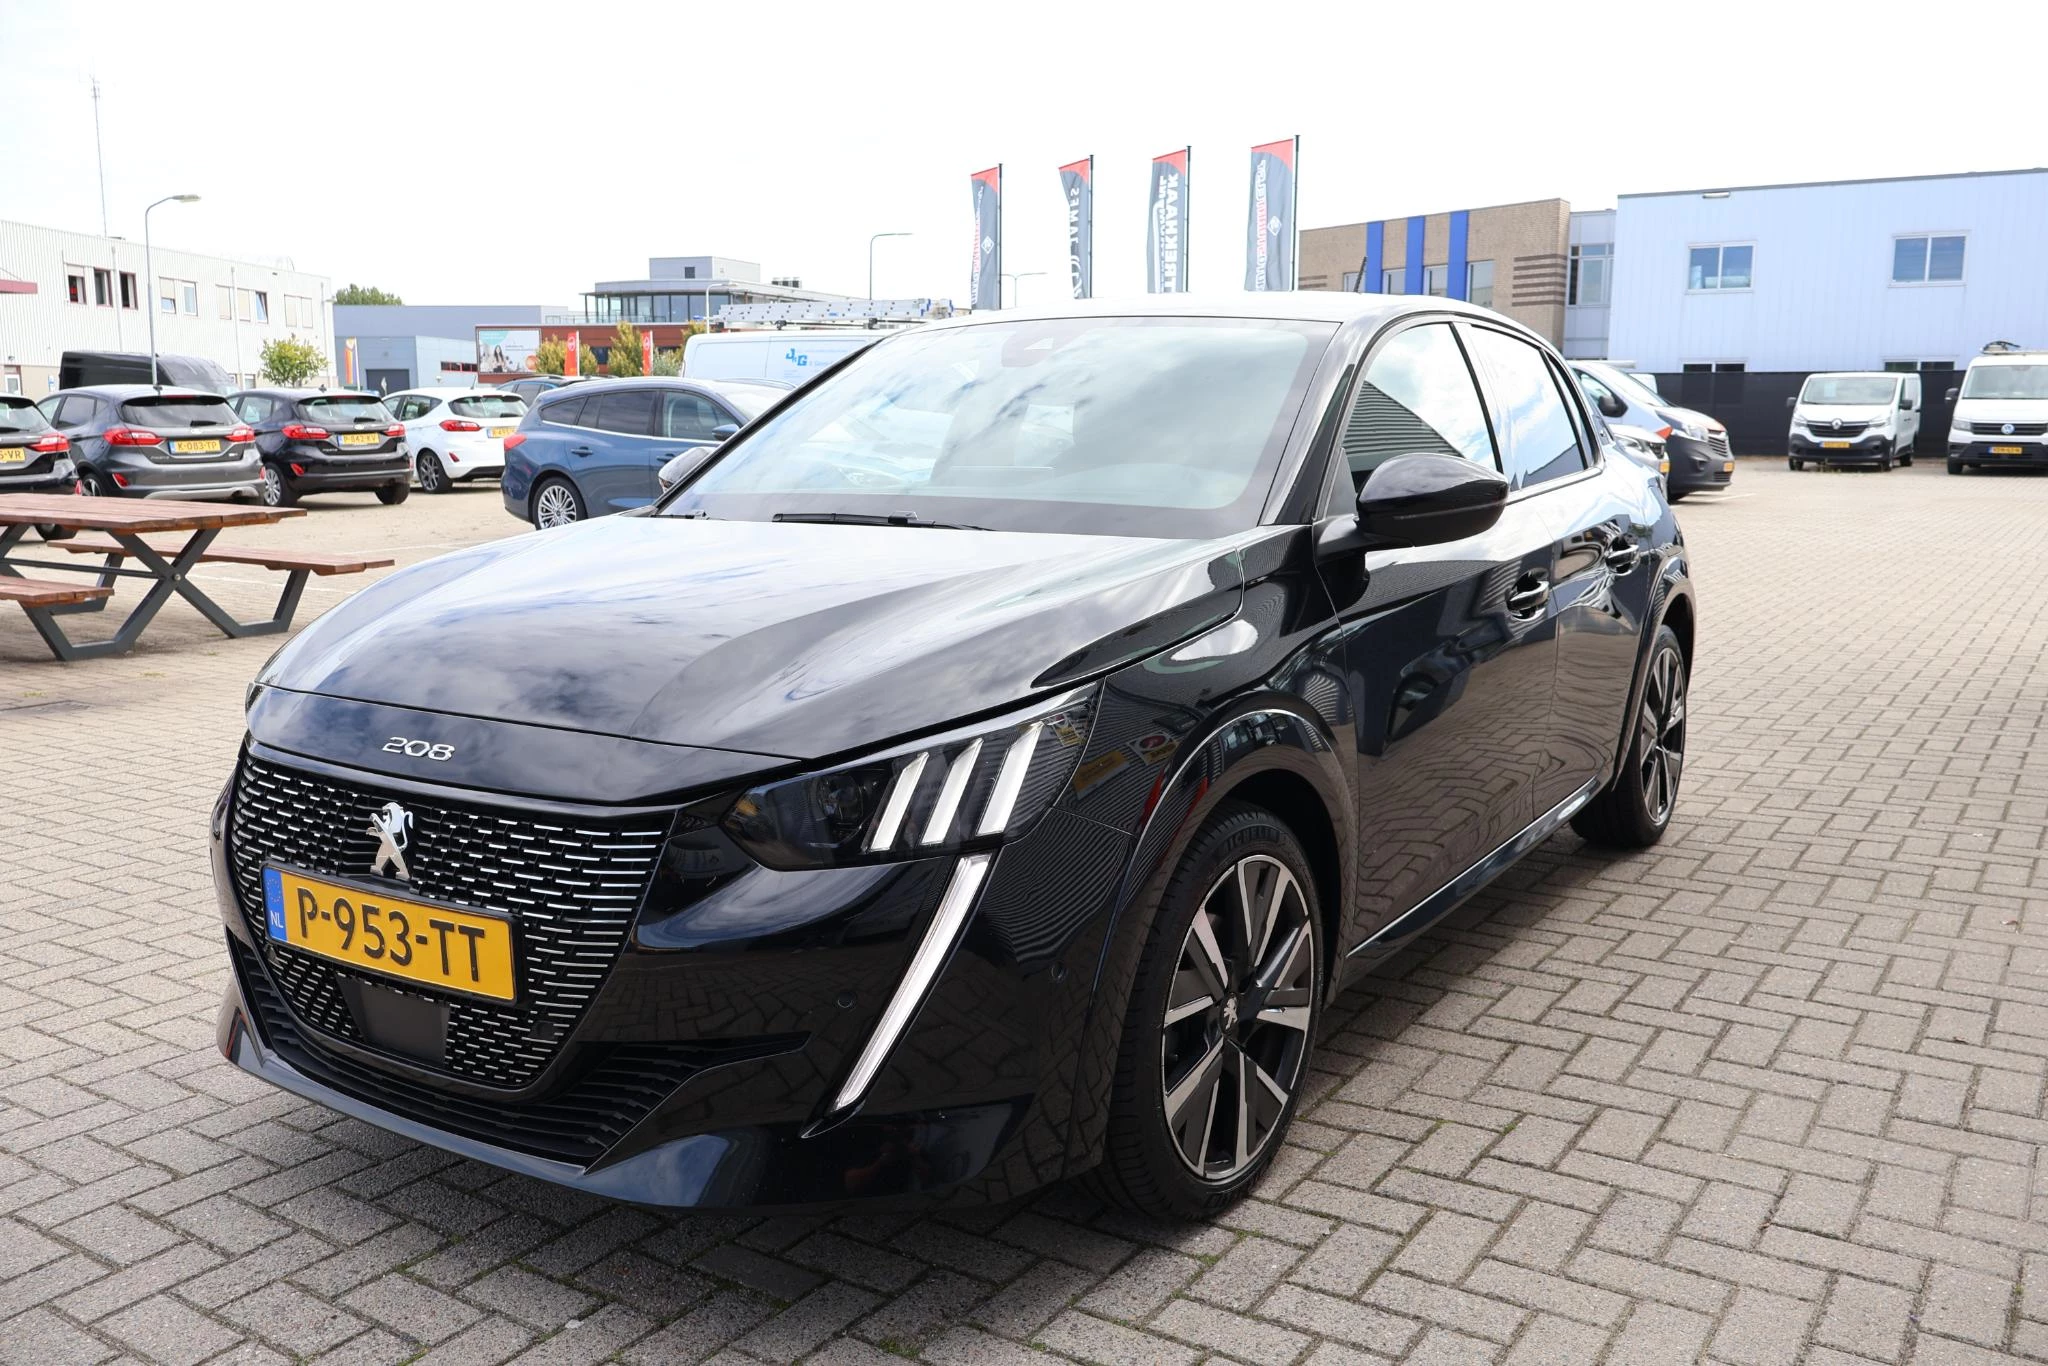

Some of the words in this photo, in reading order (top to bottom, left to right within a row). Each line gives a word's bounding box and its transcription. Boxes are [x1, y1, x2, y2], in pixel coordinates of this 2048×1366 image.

[382, 737, 456, 761] 208
[270, 912, 284, 929] NL
[297, 887, 485, 982] P-953-TT
